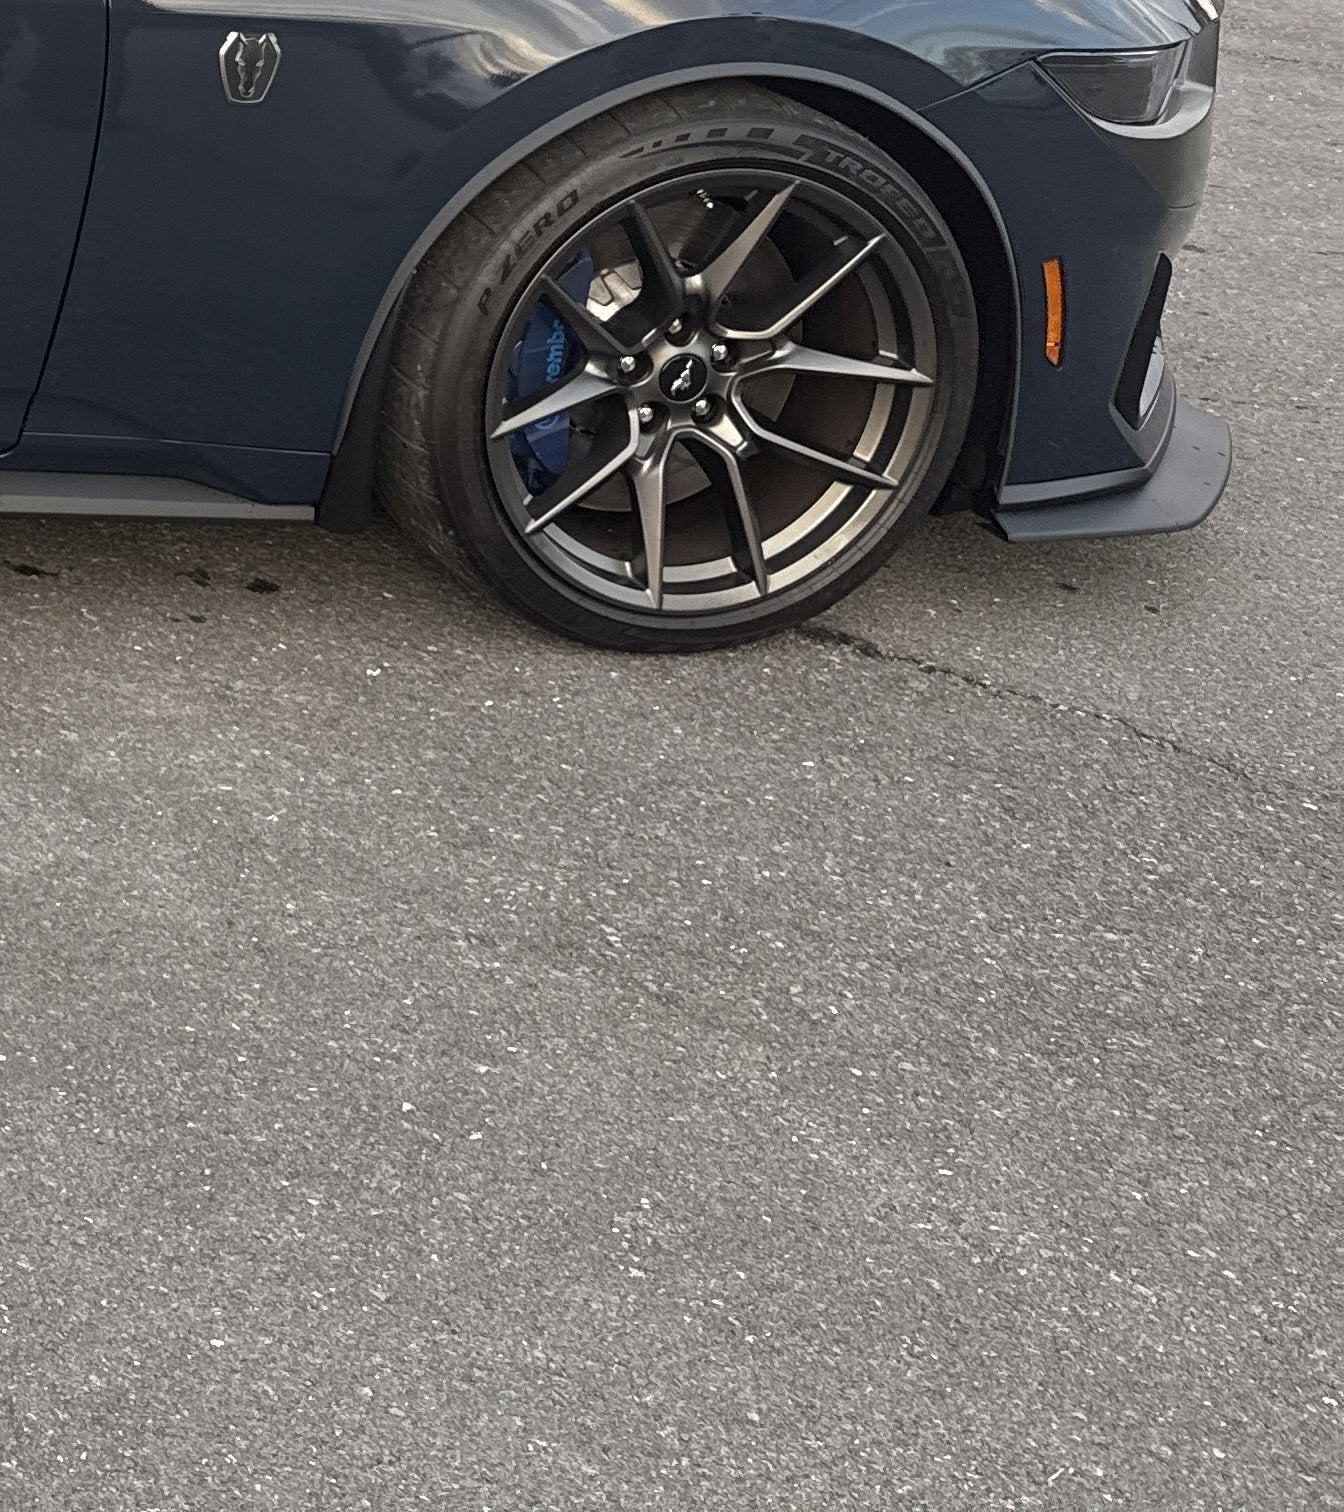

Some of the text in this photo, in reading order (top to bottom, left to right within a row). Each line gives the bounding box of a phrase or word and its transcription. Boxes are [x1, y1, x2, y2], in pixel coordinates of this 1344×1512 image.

[477, 189, 579, 316] P ZERO
[545, 319, 565, 384] remb
